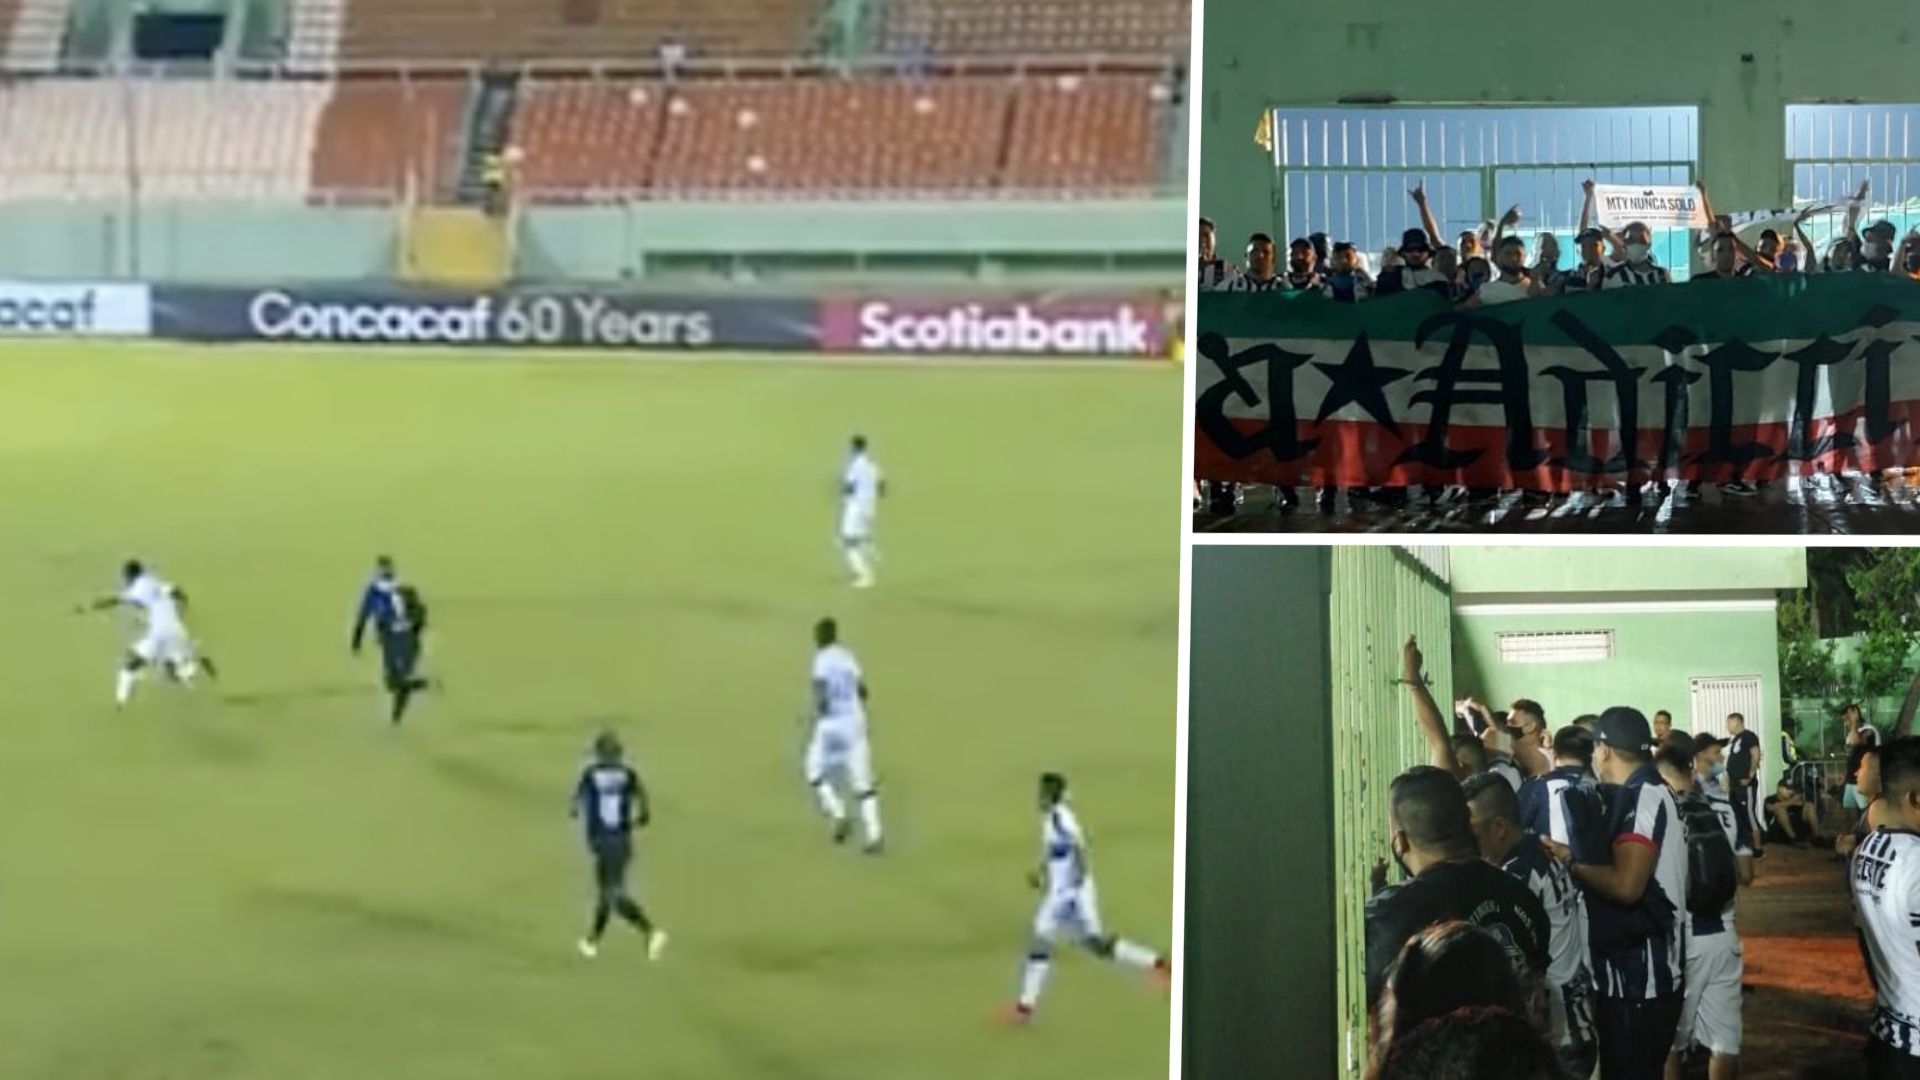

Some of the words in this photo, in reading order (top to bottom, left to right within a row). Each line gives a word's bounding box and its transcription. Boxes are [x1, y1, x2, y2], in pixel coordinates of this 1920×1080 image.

[1606, 196, 1628, 211] MTY
[1630, 197, 1667, 211] NUNCA
[1668, 198, 1696, 212] SOLO
[249, 291, 492, 340] Concacaf
[499, 298, 561, 342] 60
[574, 298, 711, 346] Years
[859, 302, 1148, 350] Scotiabank
[1392, 304, 1920, 476] Adicci
